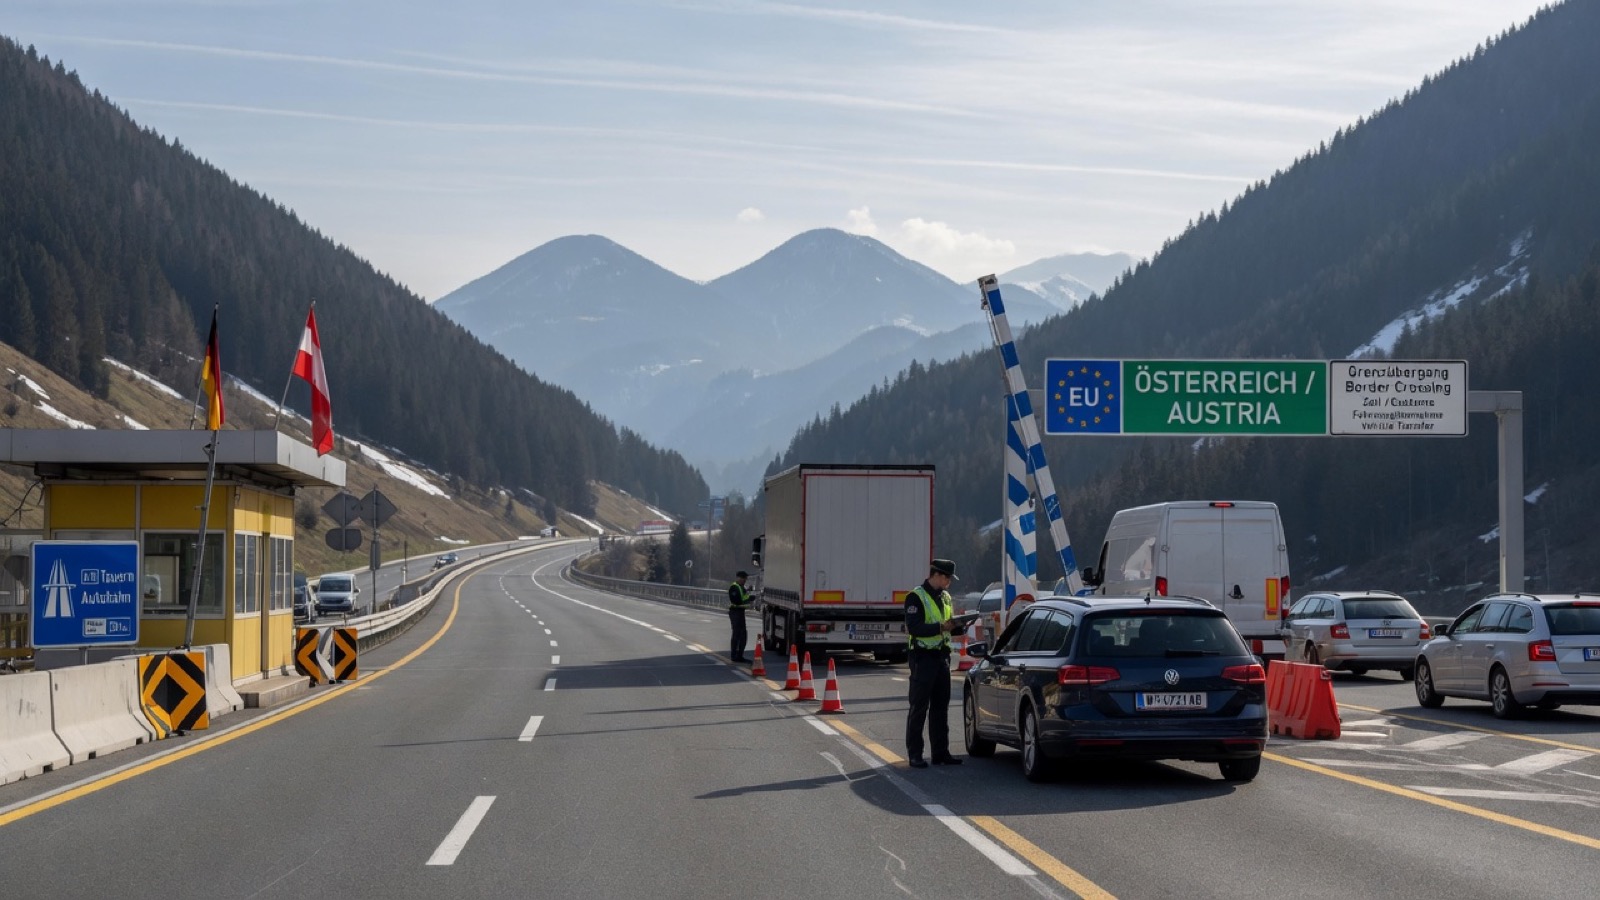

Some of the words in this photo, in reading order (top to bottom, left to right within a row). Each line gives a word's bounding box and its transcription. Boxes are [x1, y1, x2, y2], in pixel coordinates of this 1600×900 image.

[1135, 365, 1296, 394] ÖSTERREICH
[1305, 370, 1315, 395] /
[1069, 387, 1099, 407] EU
[1167, 402, 1281, 425] AUSTRIA
